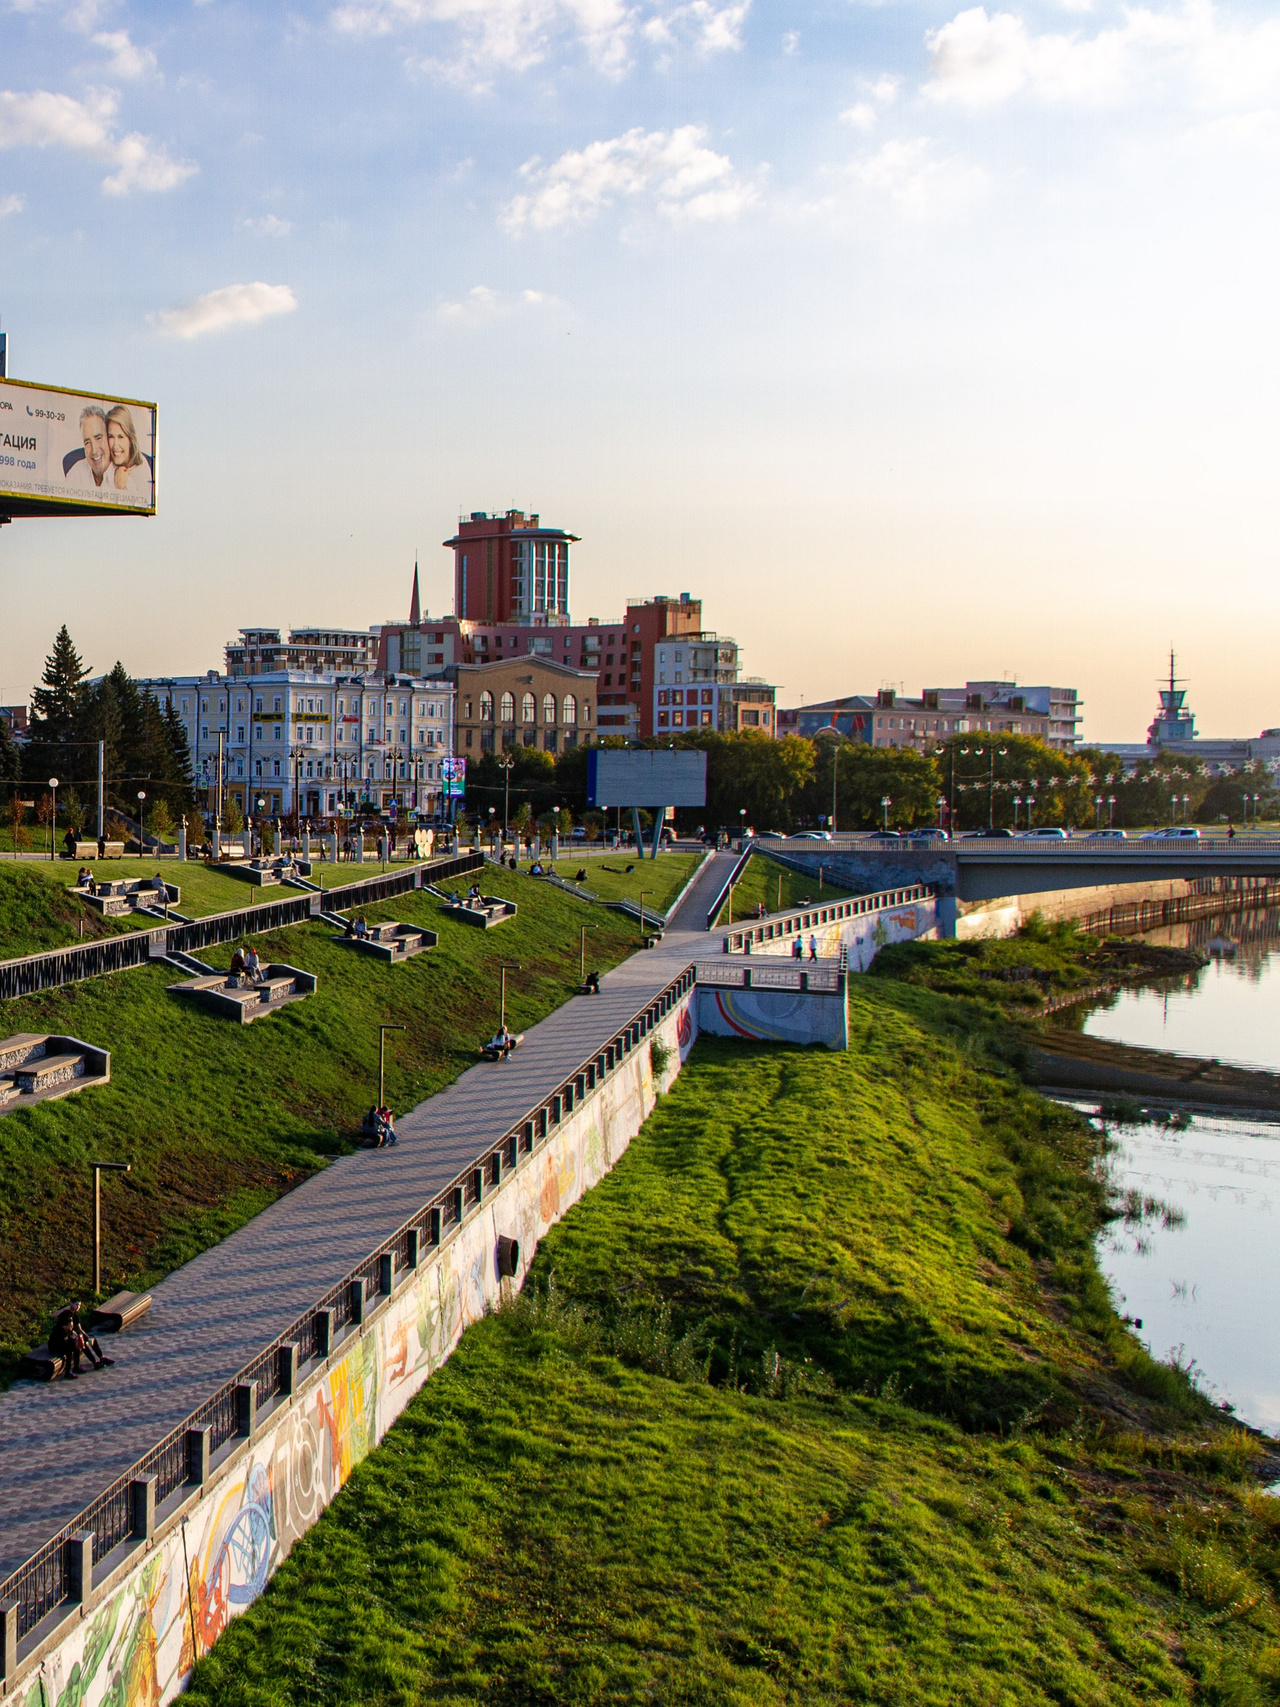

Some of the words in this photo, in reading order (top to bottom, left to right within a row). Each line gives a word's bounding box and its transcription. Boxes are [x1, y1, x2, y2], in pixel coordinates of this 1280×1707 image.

[35, 409, 65, 421] 99-30-29
[17, 459, 36, 470] года
[34, 483, 66, 494] ТРЕБУЕТСЯ
[66, 488, 109, 499] КОНСУЛЬТАЦИЯ
